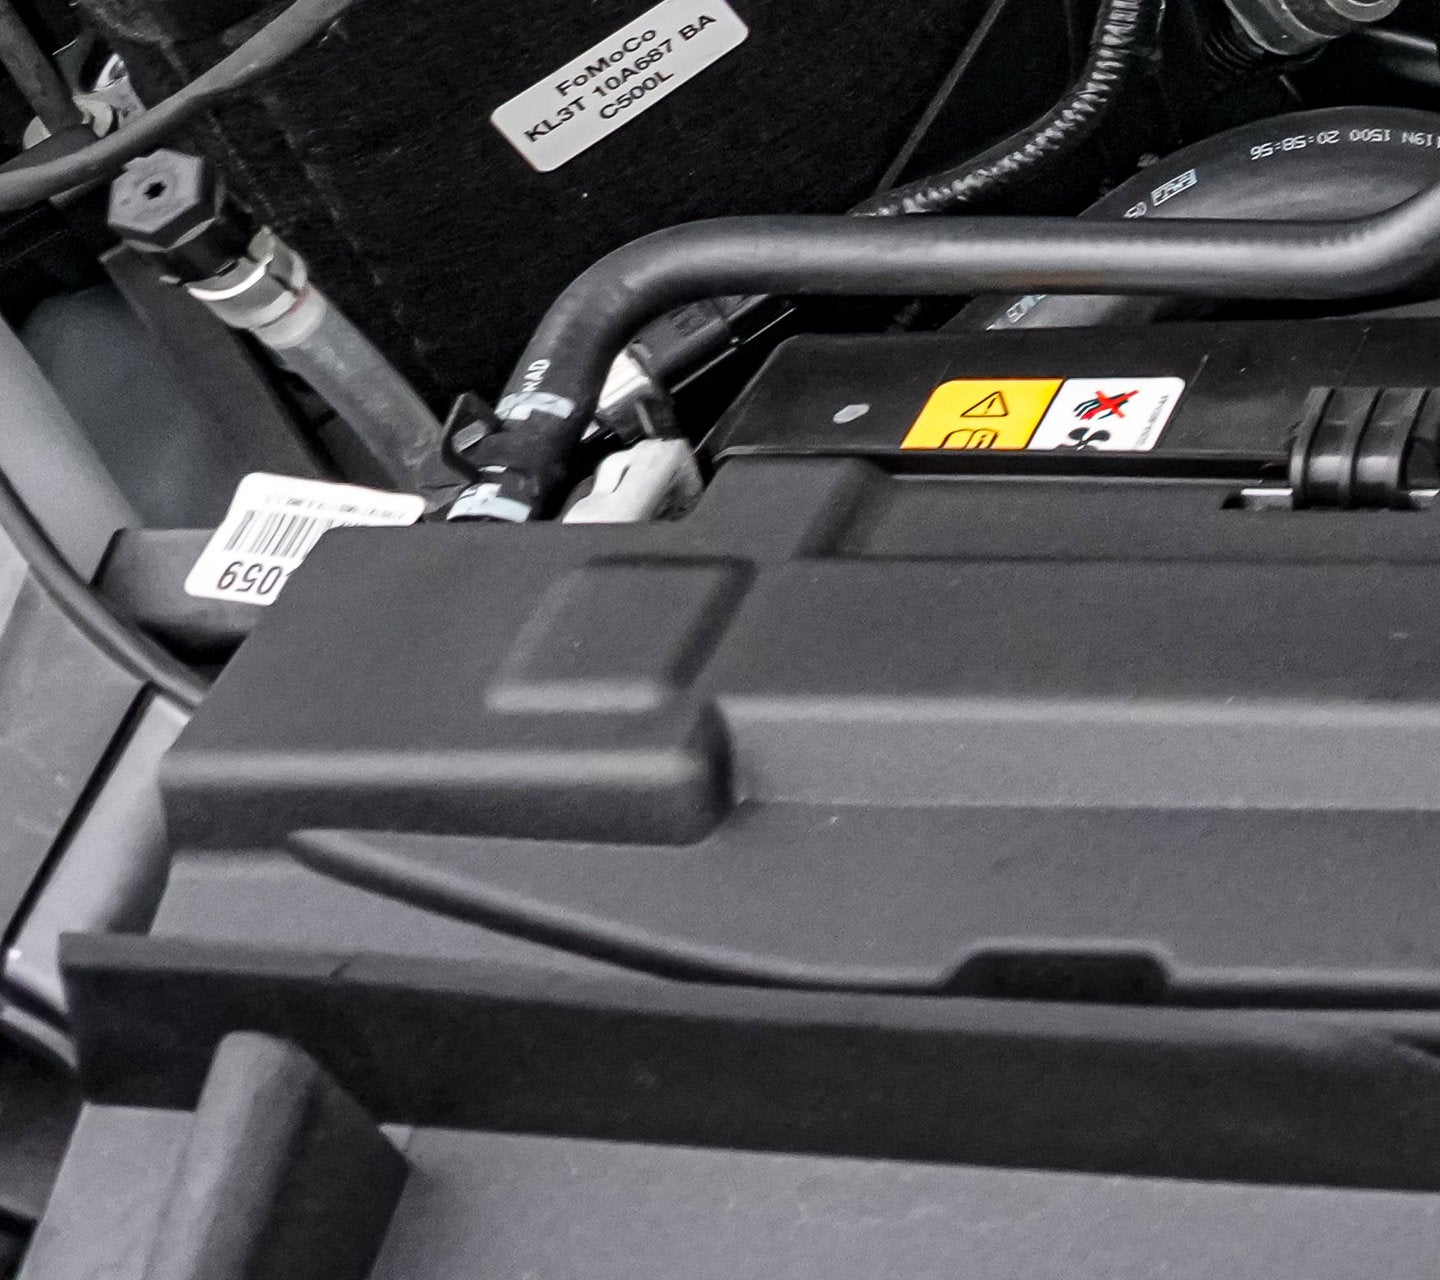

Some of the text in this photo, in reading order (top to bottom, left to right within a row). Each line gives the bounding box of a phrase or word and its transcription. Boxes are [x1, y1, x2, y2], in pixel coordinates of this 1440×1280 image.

[524, 95, 588, 143] KL3T
[679, 13, 717, 42] BA
[554, 28, 657, 98] FoMoCo
[599, 69, 675, 122] C500L
[1350, 128, 1391, 142] 1500
